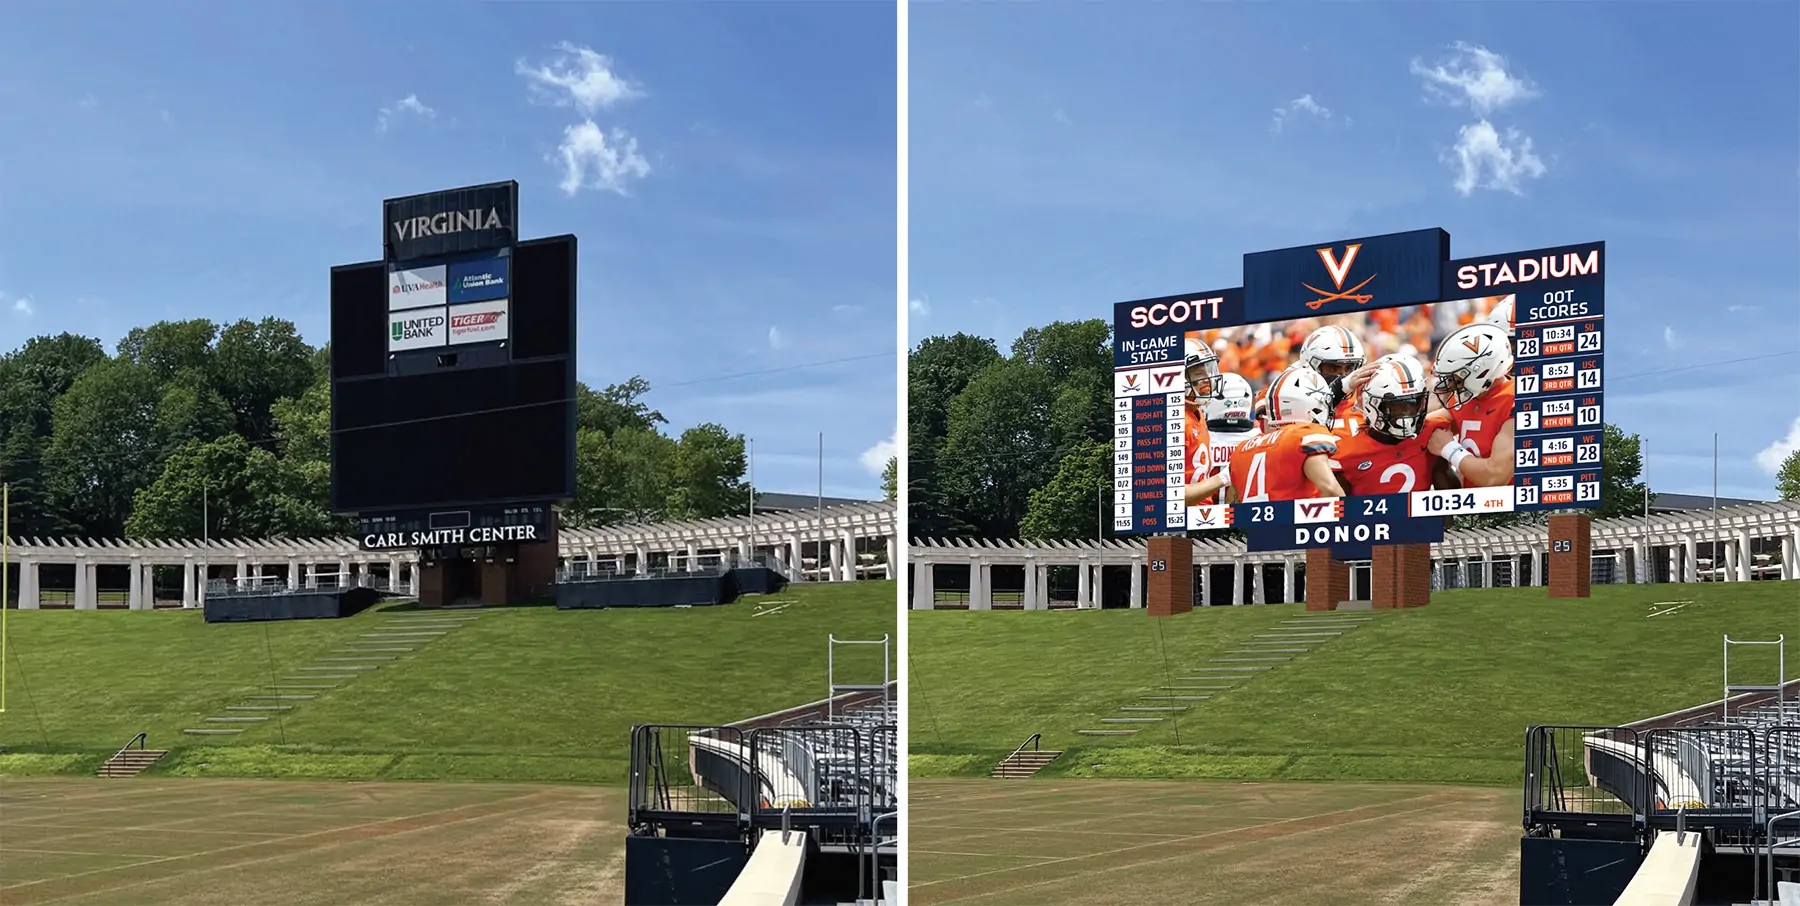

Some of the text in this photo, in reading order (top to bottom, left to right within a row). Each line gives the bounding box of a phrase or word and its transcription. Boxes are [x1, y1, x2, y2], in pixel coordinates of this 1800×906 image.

[393, 206, 502, 241] VIRGINIA
[1457, 250, 1598, 289] STADIUM
[462, 277, 504, 288] Union Bank
[463, 273, 492, 282] Atlantic
[1544, 290, 1574, 304] OOT
[1130, 297, 1223, 328] SCOTT
[1529, 302, 1588, 320] SCORES
[404, 316, 444, 330] UNITED
[453, 314, 485, 326] TIGER
[1585, 323, 1594, 331] SU
[404, 327, 434, 340] BANK
[1521, 330, 1535, 338] FSU
[1546, 329, 1571, 340] 10:34
[1122, 335, 1177, 352] IN-GAME
[1520, 340, 1536, 355] 28
[1580, 334, 1597, 349] 24
[1560, 344, 1572, 352] QTR
[1131, 349, 1168, 363] STATS
[1520, 366, 1535, 374] UNC
[1548, 365, 1568, 375] 8:52
[1582, 360, 1596, 368] USC
[1153, 371, 1182, 387] VT
[1520, 377, 1535, 391] 17
[1560, 380, 1572, 388] QTR
[1581, 371, 1597, 386] 14
[1583, 397, 1595, 405] UM
[1546, 402, 1570, 413] 11:54
[1136, 412, 1152, 420] RUSH
[1524, 413, 1531, 428] 3
[1559, 417, 1572, 425] QTR
[1580, 408, 1596, 422] 10
[1548, 440, 1567, 450] 4:16
[1519, 450, 1536, 465] 34
[1559, 455, 1571, 463] QTR
[1580, 446, 1597, 461] 28
[1134, 464, 1165, 473] 3RD DOWN
[1168, 463, 1183, 471] 6/10
[1134, 478, 1146, 486] 4TH
[1243, 452, 1269, 502] 4
[1580, 473, 1596, 481] PITT
[1118, 480, 1128, 488] 0/2
[1548, 479, 1567, 488] 5:35
[1136, 491, 1163, 499] FUMBLES
[1520, 488, 1534, 502] 31
[1581, 484, 1595, 498] 31
[1363, 499, 1388, 515] 24
[1422, 493, 1476, 511] 10:34
[1484, 499, 1503, 508] 4TH
[1251, 506, 1274, 522] 28
[1299, 502, 1331, 518] VT
[1168, 516, 1183, 524] 15:25
[364, 525, 537, 548] CARL SMITH CENTER
[1295, 523, 1390, 545] DONOR
[1554, 541, 1570, 552] 25
[1152, 561, 1165, 571] 25
